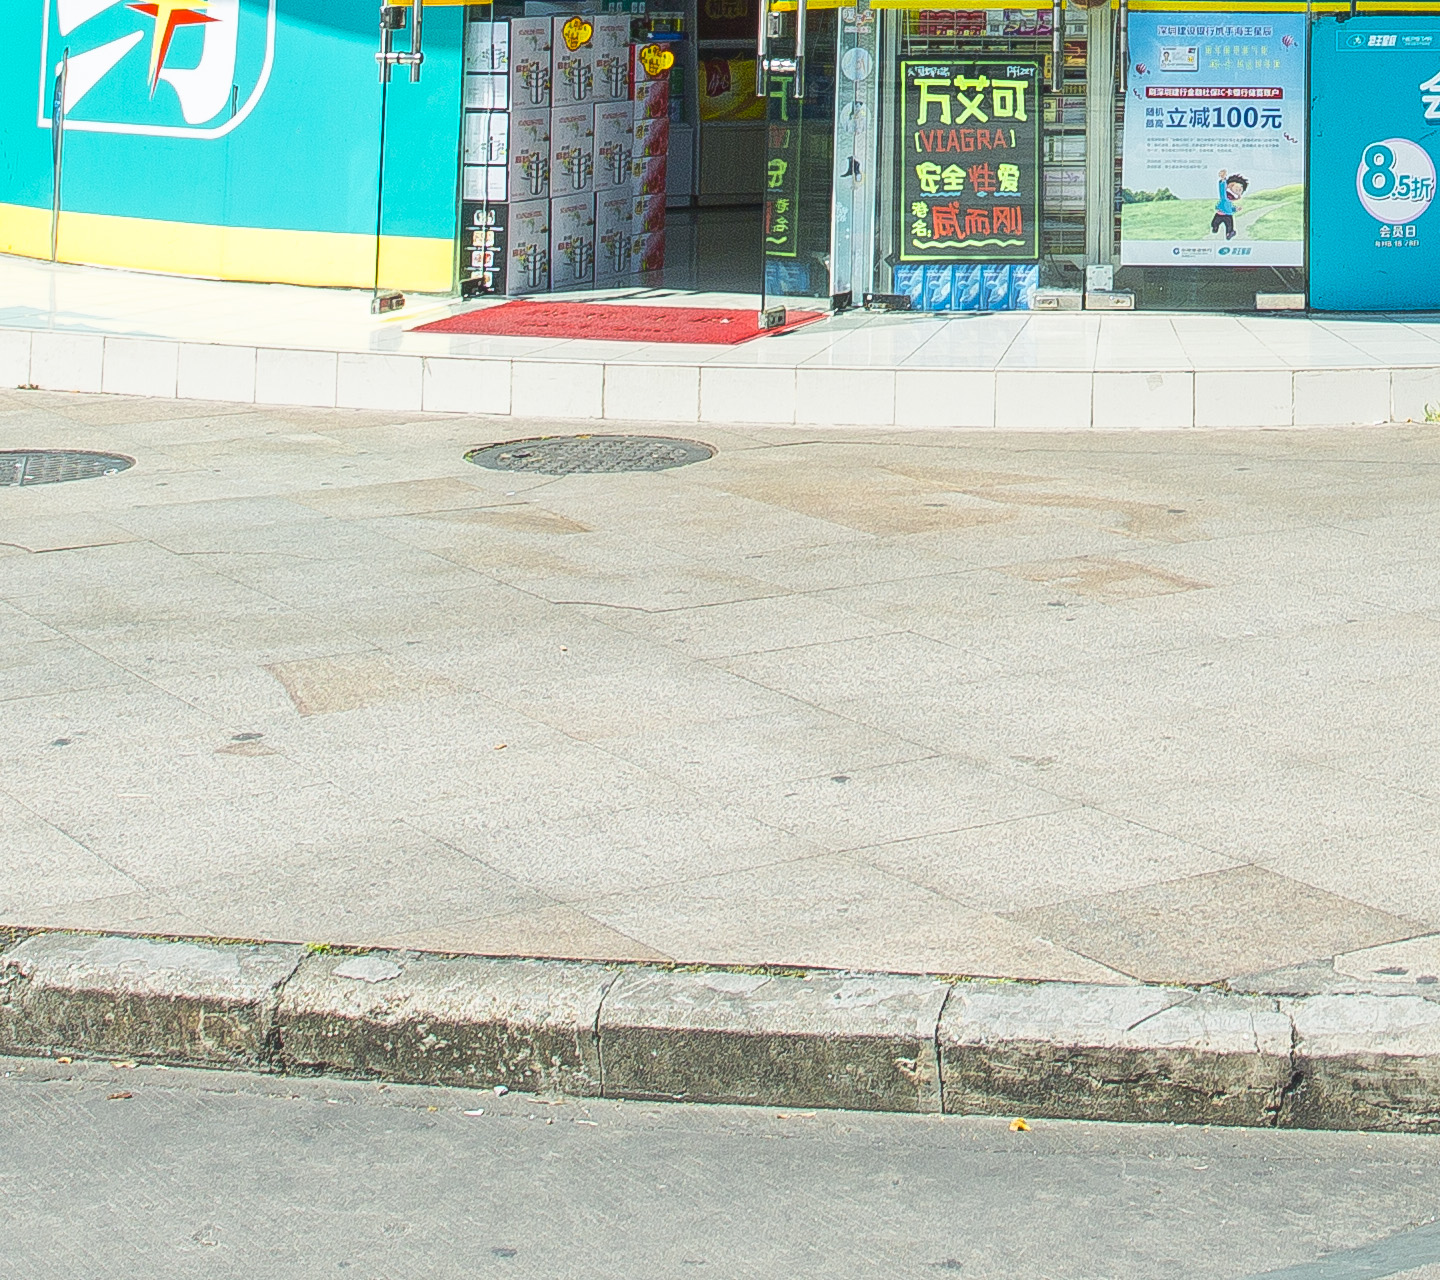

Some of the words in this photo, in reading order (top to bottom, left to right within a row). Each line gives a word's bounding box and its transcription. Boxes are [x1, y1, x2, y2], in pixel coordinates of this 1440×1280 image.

[913, 74, 1029, 125] 万艾可
[1146, 107, 1164, 117] 随机
[1146, 119, 1164, 128] 最高
[1166, 107, 1282, 129] 立减100元
[915, 162, 1021, 193] 安全性爱
[1362, 143, 1434, 202] 8.5折
[932, 201, 1023, 240] 威而刚
[1379, 225, 1417, 238] 会员日
